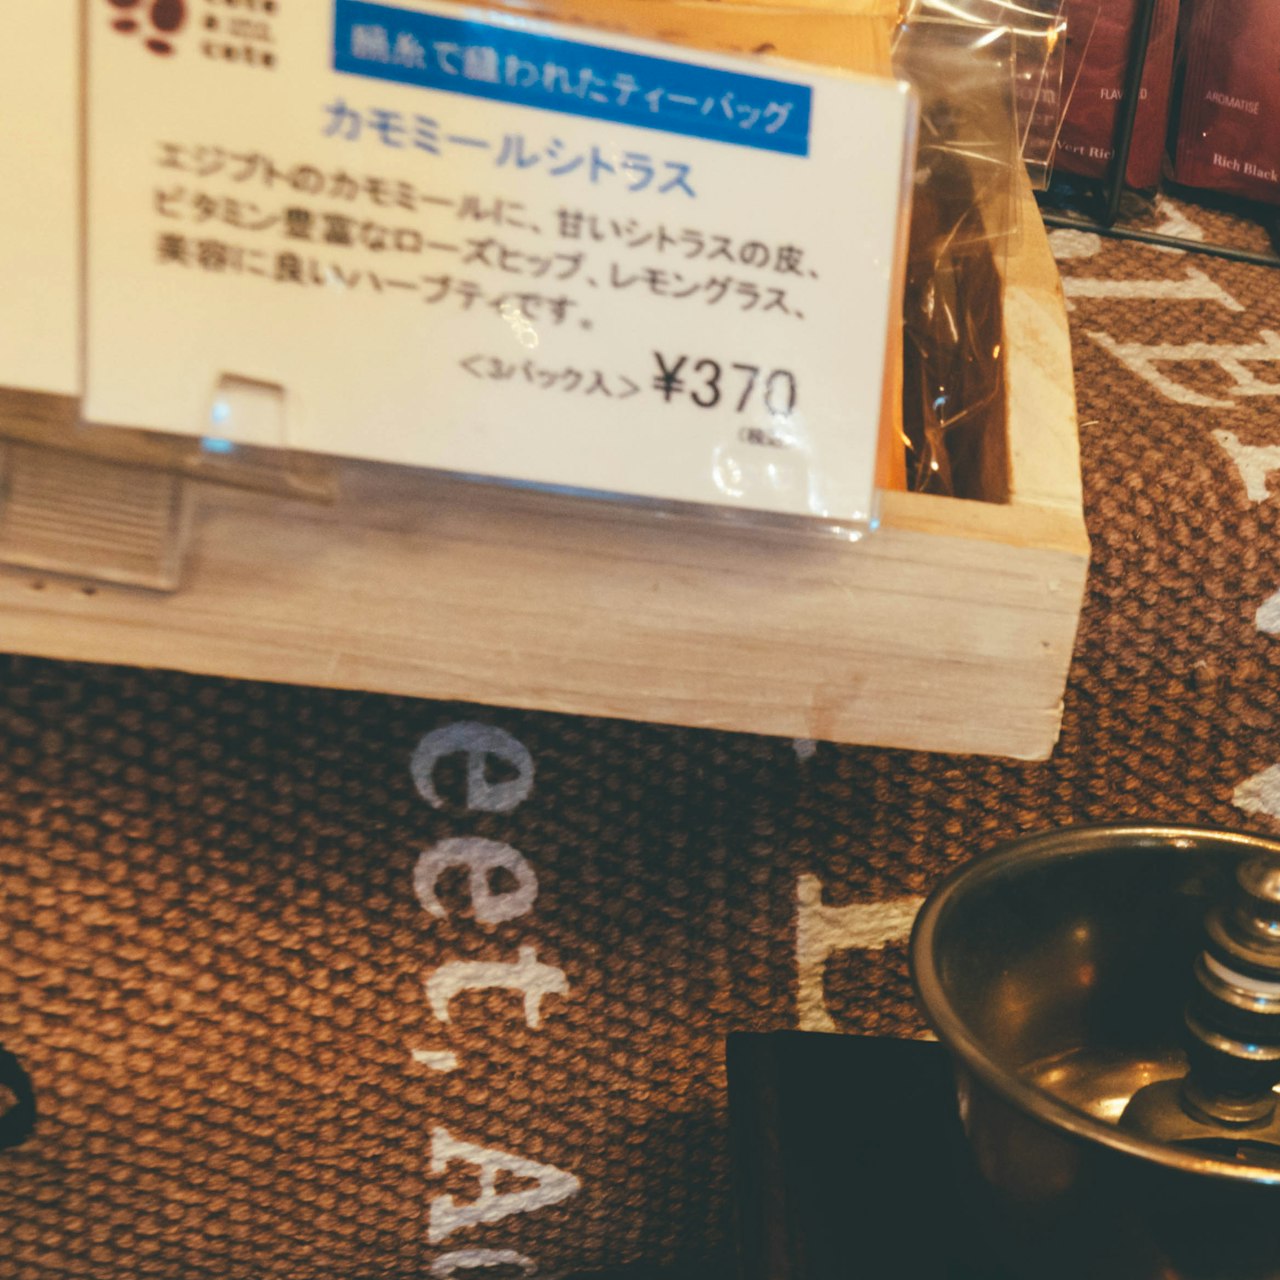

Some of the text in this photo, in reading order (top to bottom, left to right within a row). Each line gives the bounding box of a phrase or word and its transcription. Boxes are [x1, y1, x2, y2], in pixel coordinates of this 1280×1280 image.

[1206, 89, 1260, 115] AROMATISÉ
[322, 99, 697, 199] カモミールシトラス
[1213, 153, 1241, 174] Rich
[1243, 160, 1279, 184] Black
[652, 350, 798, 417] ¥370
